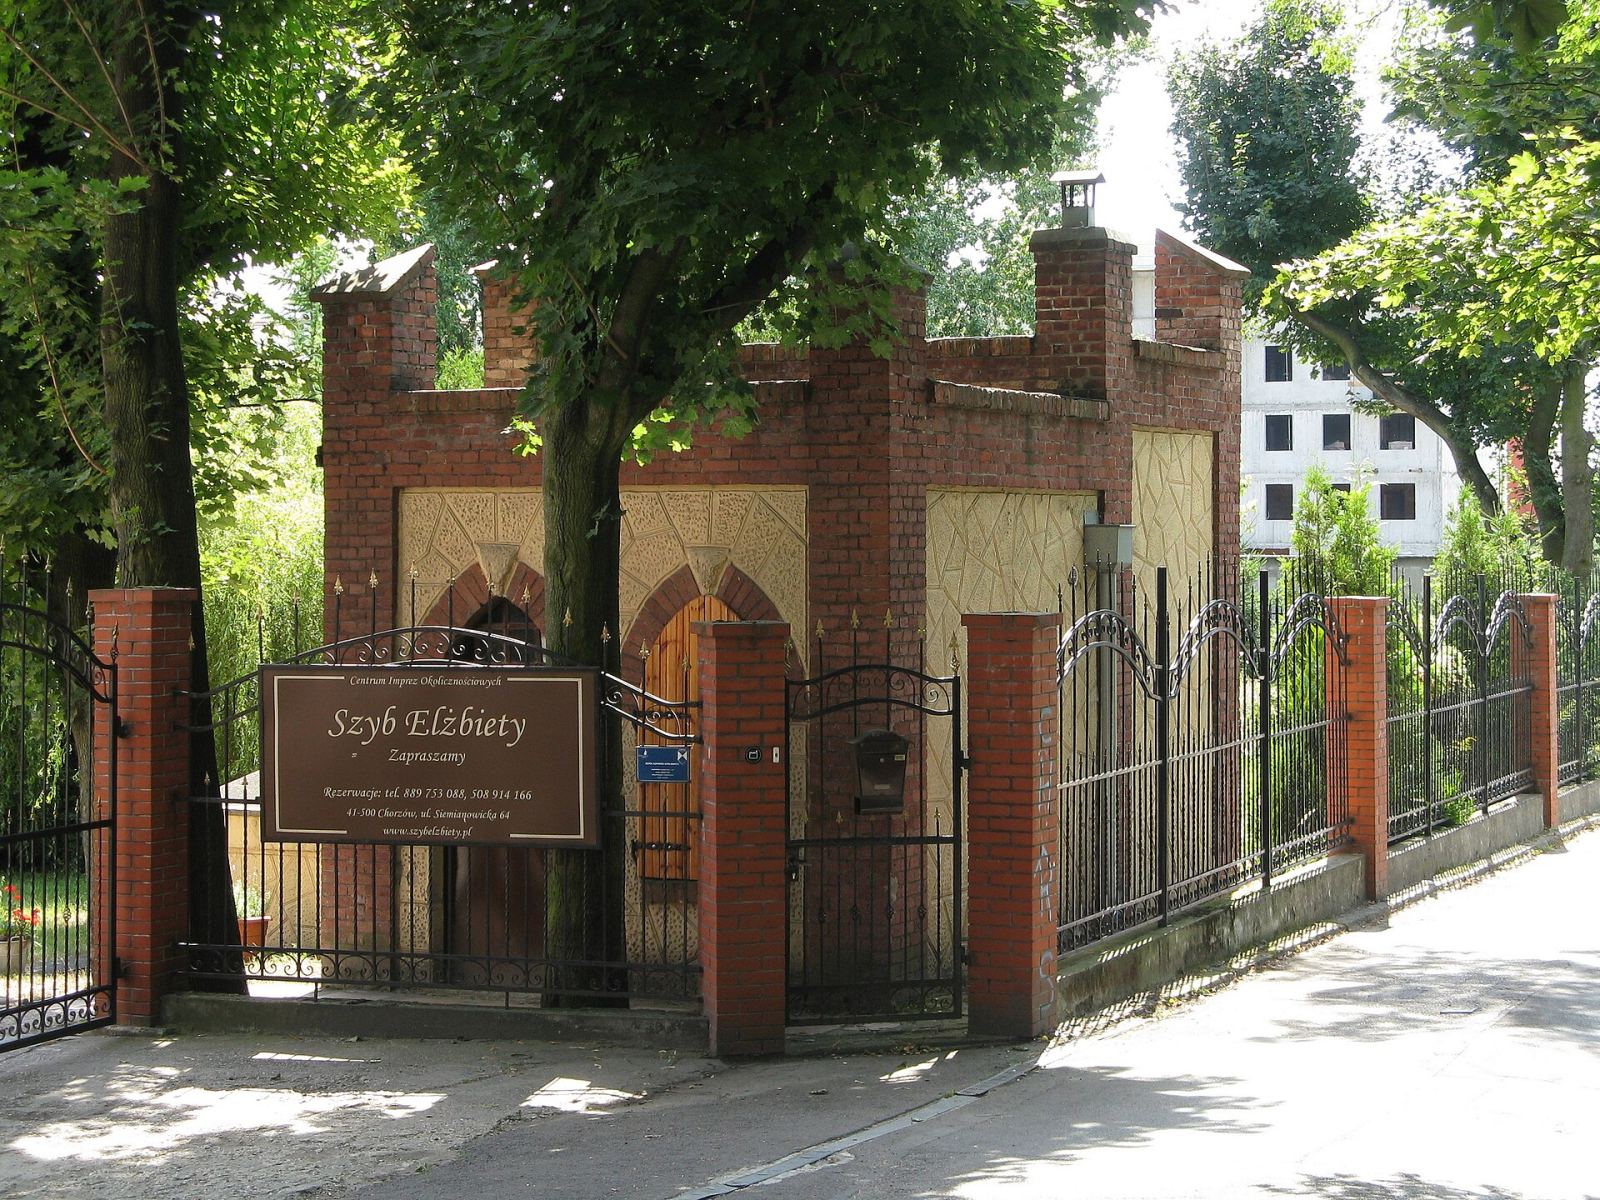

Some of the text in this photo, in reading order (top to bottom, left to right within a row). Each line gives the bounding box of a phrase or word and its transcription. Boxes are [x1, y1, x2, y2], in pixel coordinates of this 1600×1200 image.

[350, 675, 502, 689] Centrum Imprez Okolicznościowych
[327, 705, 526, 747] Szyb Elżbiety
[388, 748, 466, 766] Zapraszamy
[323, 786, 532, 801] Rezerwacje: tel. 889 753 088, 508 914 166
[346, 807, 511, 822] 41-500 Chorzów, ul. Siemianowicka 64
[383, 826, 473, 840] www.szybelzbiety.pl
